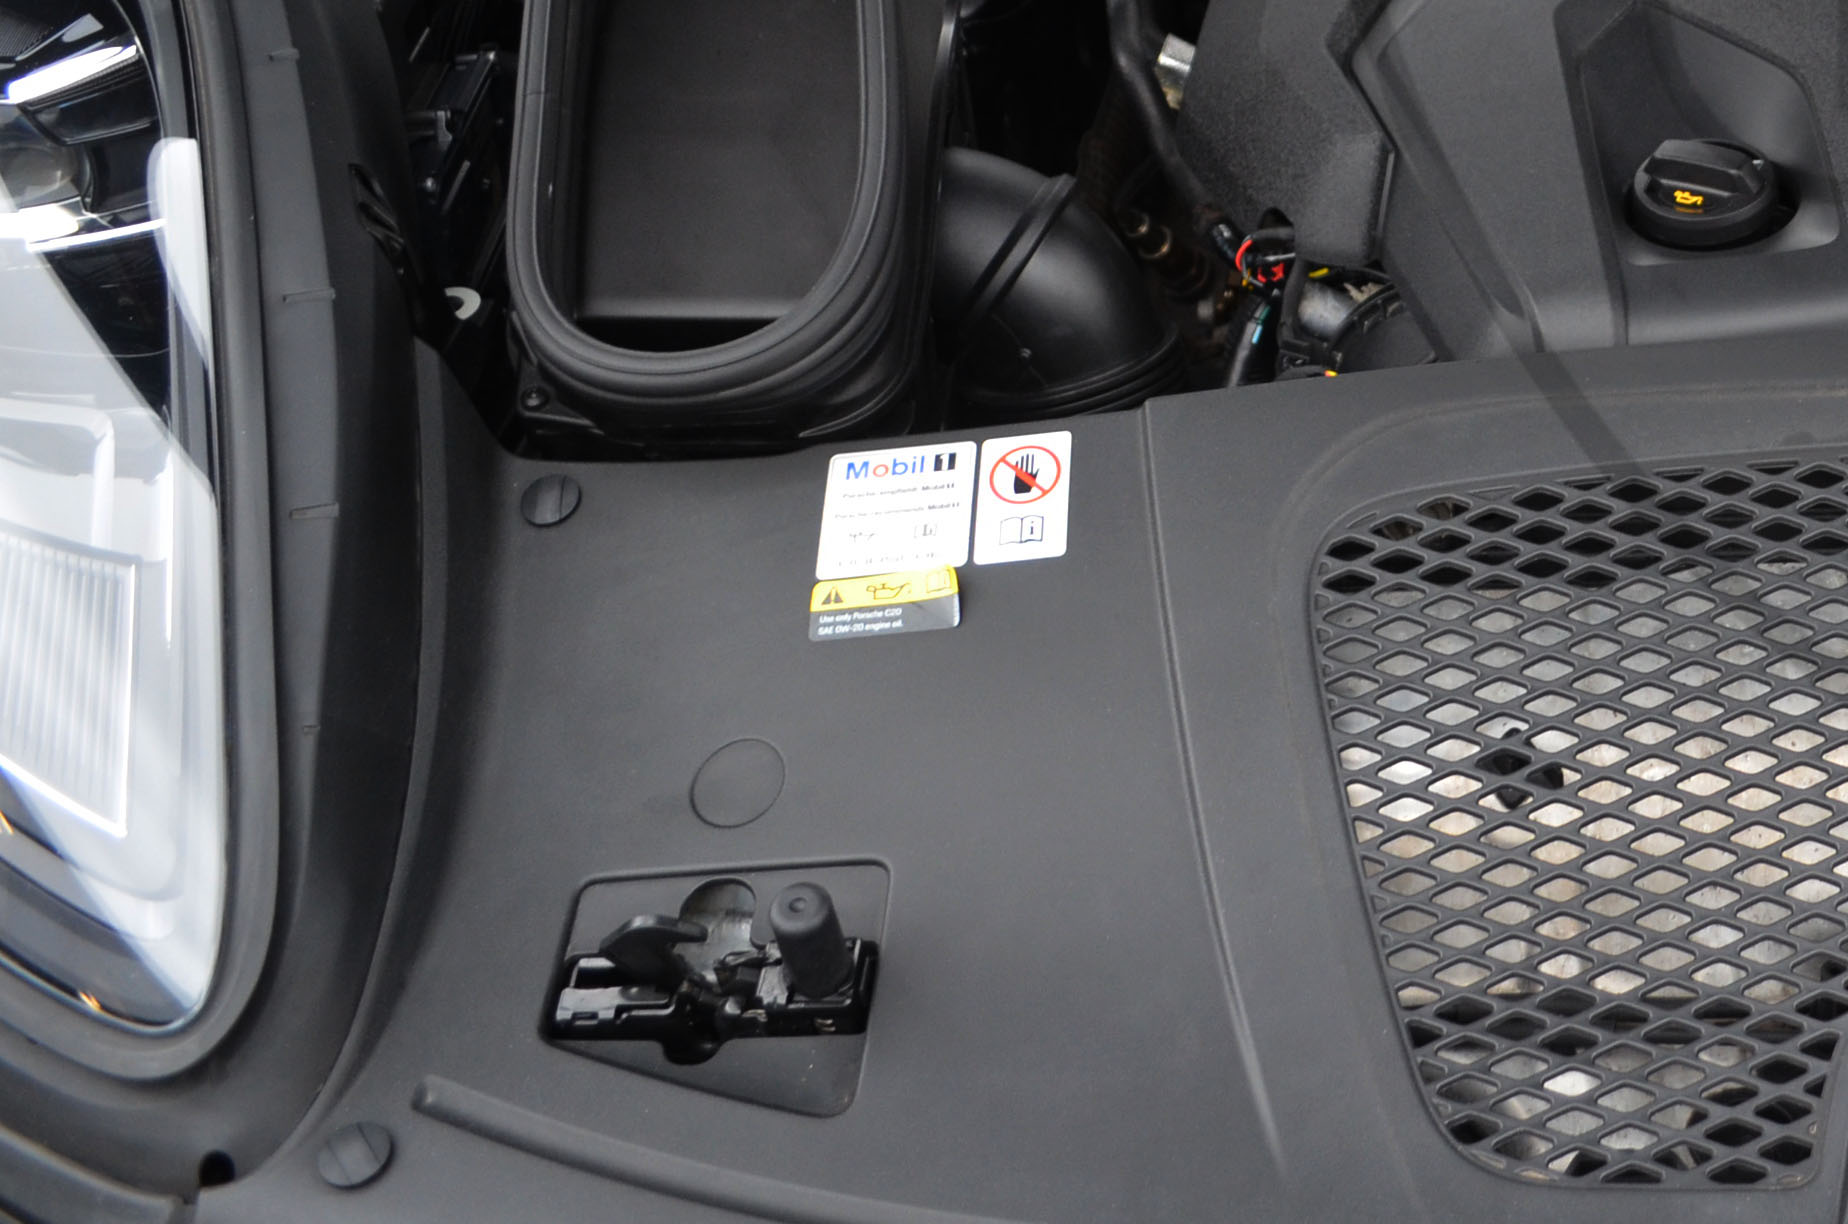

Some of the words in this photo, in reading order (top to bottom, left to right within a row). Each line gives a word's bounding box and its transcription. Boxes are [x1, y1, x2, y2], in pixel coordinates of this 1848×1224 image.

[845, 455, 925, 480] Mobil
[934, 452, 956, 472] 1
[819, 615, 834, 624] Use
[835, 613, 852, 622] only
[853, 609, 884, 620] Porsche
[884, 607, 902, 617] C20
[818, 625, 834, 635] SAE
[864, 621, 891, 631] engine
